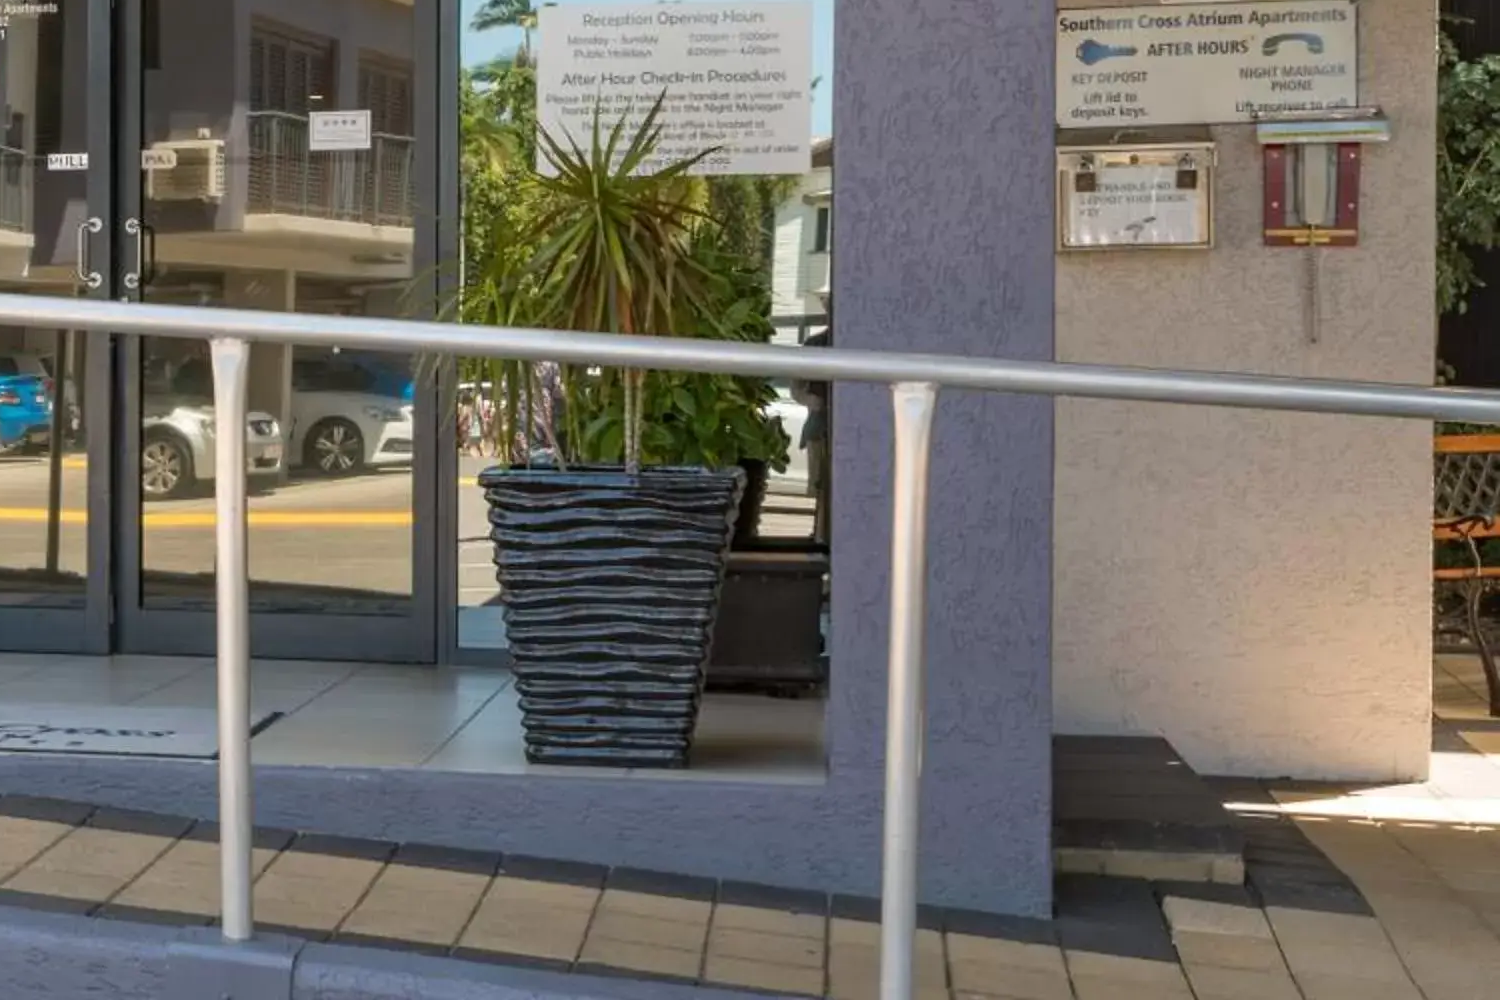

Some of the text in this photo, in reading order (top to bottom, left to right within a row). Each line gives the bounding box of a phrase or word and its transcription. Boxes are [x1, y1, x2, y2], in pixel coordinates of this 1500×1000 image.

[582, 9, 765, 28] Reception Opening Hours
[1060, 7, 1348, 32] Southern Cross Atrium Apartments
[1147, 39, 1250, 56] AFTER HOURS
[561, 68, 787, 87] After Hour Check-in Procedures
[1071, 71, 1148, 84] KEY DEPOSIT
[1239, 62, 1347, 80] NIGHT MANAGER
[1270, 79, 1313, 93] PHONE
[1084, 91, 1102, 104] Lift
[1125, 91, 1138, 102] to
[1071, 106, 1117, 120] deposit
[49, 155, 86, 167] PULL
